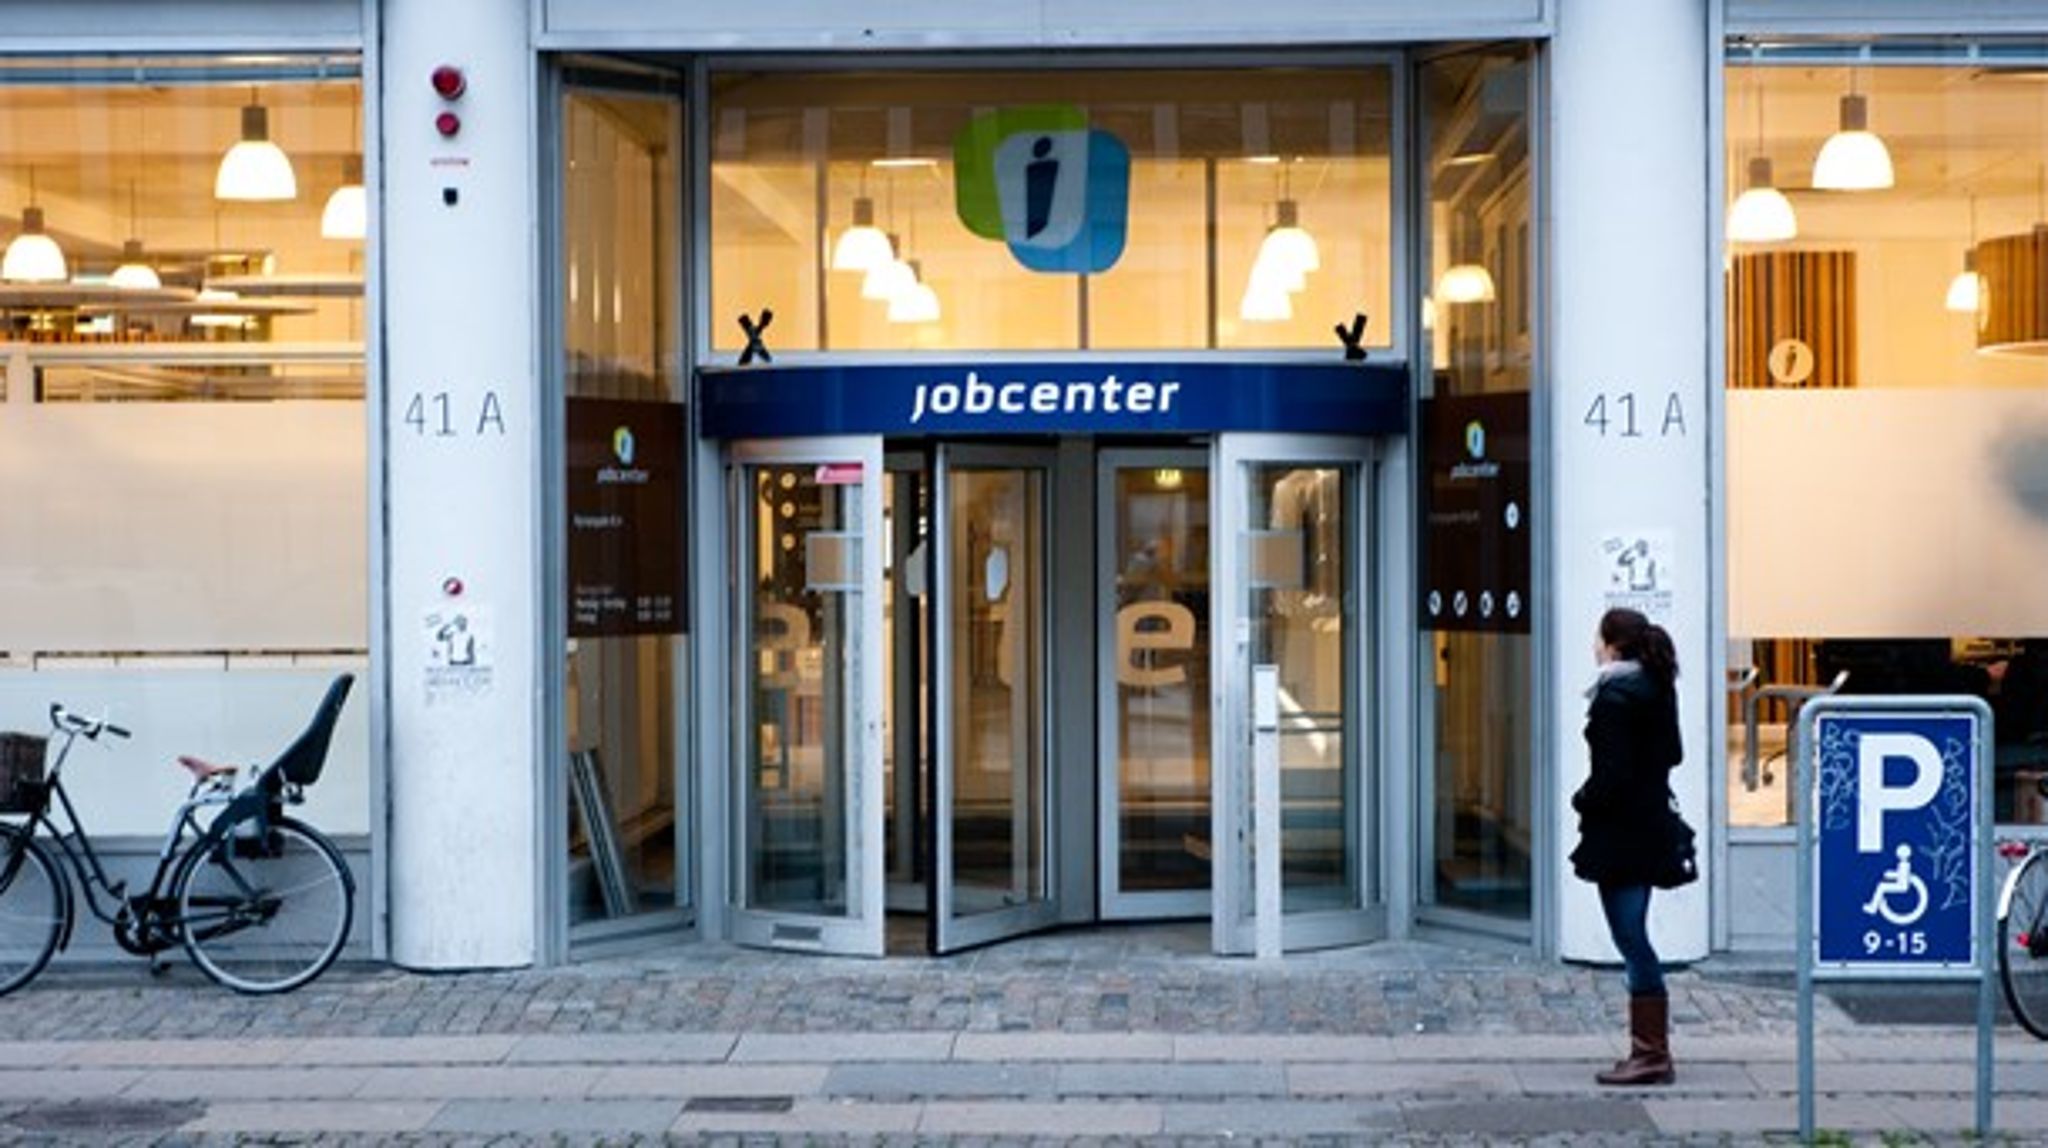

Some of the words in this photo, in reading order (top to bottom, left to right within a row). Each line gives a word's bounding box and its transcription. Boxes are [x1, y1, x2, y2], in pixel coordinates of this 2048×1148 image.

[405, 392, 457, 436] 41
[477, 391, 504, 435] A
[910, 371, 1180, 424] jobcenter
[1584, 392, 1641, 437] 41
[1660, 391, 1686, 437] A
[1857, 732, 1944, 853] P
